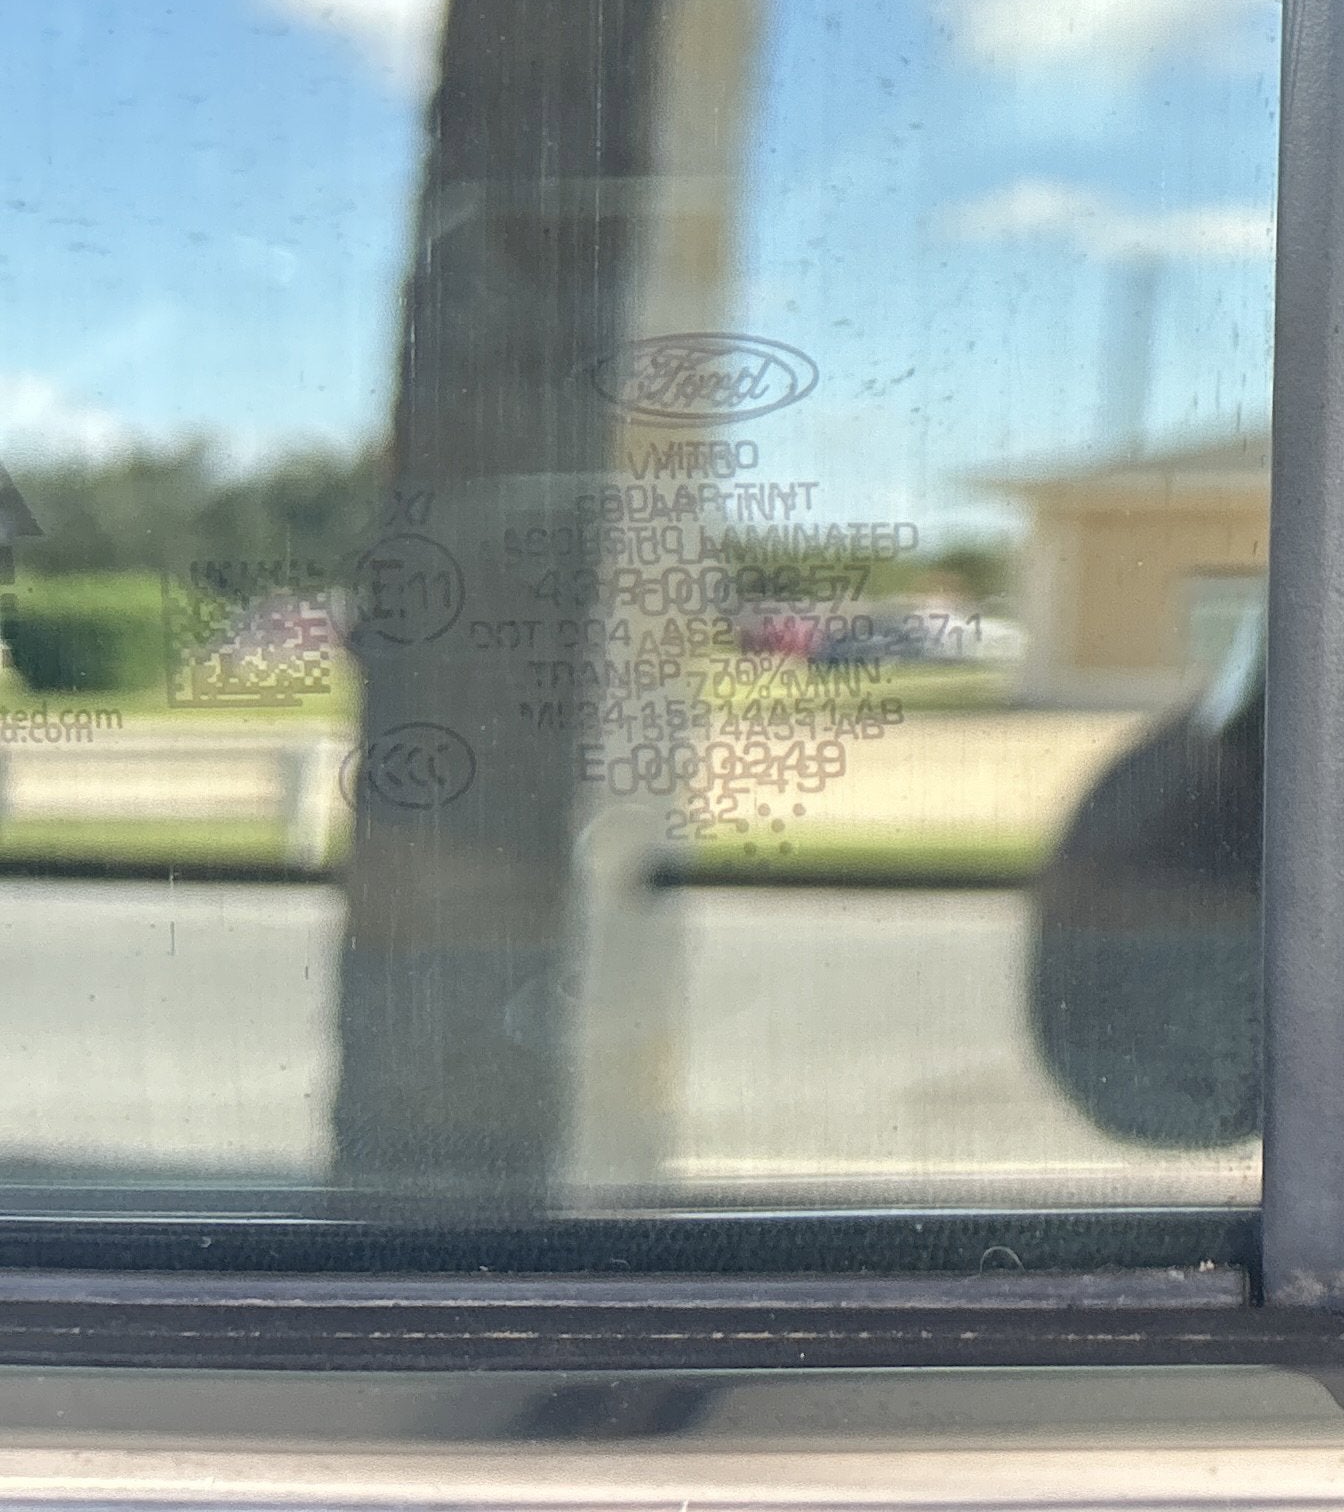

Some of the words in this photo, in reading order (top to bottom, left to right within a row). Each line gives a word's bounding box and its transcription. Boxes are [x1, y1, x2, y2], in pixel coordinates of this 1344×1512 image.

[647, 439, 759, 472] VITRO
[596, 482, 718, 513] SOLAR
[732, 480, 821, 512] TINT
[697, 521, 920, 556] LAMINATED
